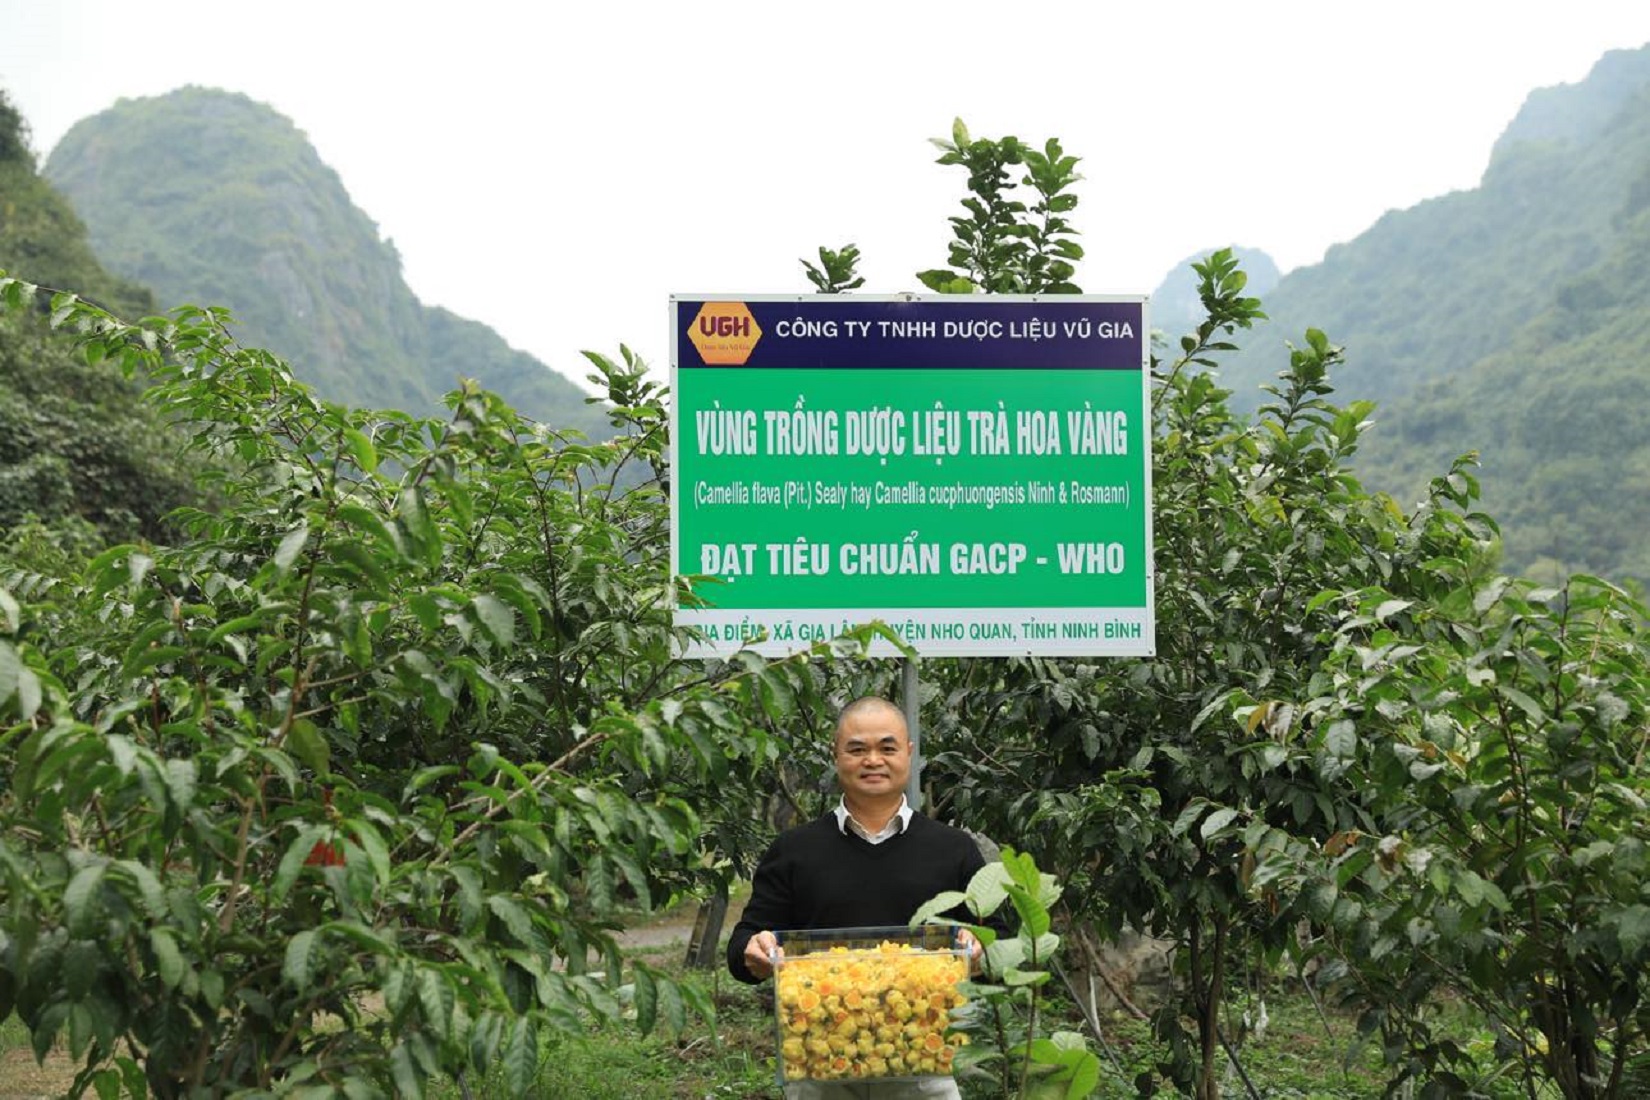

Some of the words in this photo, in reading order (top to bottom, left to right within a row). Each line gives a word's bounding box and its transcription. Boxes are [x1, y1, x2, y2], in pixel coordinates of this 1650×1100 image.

[776, 317, 838, 337] CÔNG
[844, 321, 872, 337] TY
[878, 321, 936, 338] TNHH
[944, 319, 1003, 342] DƯỢC
[1010, 317, 1056, 342] LIỆU
[1063, 318, 1091, 338] VŨ
[1098, 321, 1134, 338] GIA
[696, 400, 757, 455] VÙNG
[764, 394, 839, 455] TRỒNG
[845, 406, 906, 466] DƯỢC
[912, 401, 961, 466] LIỆU
[967, 400, 1010, 455] TRÀ
[1016, 411, 1061, 455] HOA
[1067, 400, 1128, 455] VÀNG
[694, 481, 749, 509] (Camellia
[752, 481, 780, 504] flava
[784, 481, 812, 509] (Pit.)
[815, 481, 847, 509] Sealy
[851, 481, 871, 509] hay
[875, 481, 925, 504] Camellia
[930, 481, 1025, 509] cucphuongensis
[1028, 481, 1055, 504] Ninh
[1059, 481, 1067, 504] &
[1071, 481, 1130, 509] Rosmann)
[701, 543, 757, 583] ĐẠT
[766, 537, 830, 574] TIÊU
[840, 530, 940, 574] CHUẨN
[950, 542, 1027, 574] GACP
[1036, 556, 1048, 564] -
[1057, 542, 1125, 574] WHO
[773, 620, 794, 641] XÃ
[799, 623, 825, 641] GIA
[931, 623, 964, 640] NHO
[970, 623, 1016, 642] QUAN,
[1022, 617, 1056, 640] TỈNH
[1062, 623, 1098, 639] NINH
[1104, 619, 1141, 639] BÌNH
